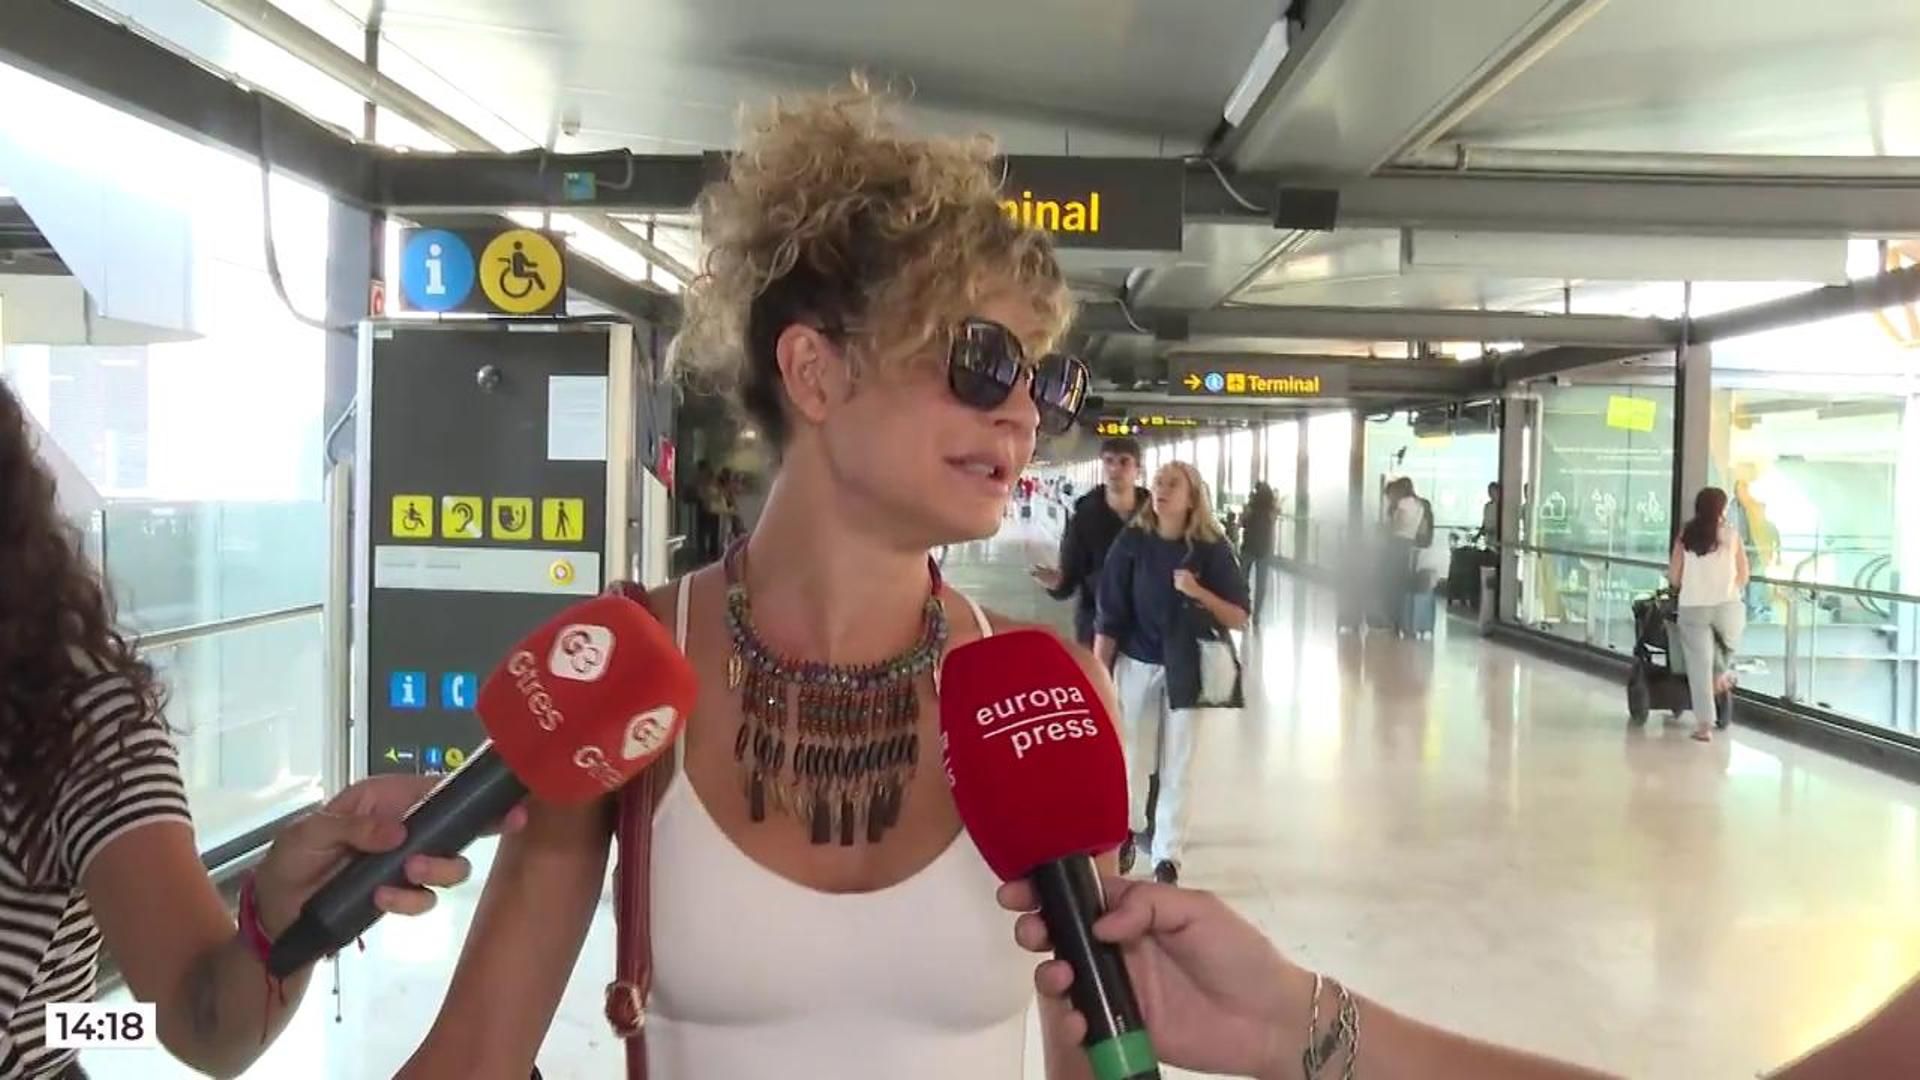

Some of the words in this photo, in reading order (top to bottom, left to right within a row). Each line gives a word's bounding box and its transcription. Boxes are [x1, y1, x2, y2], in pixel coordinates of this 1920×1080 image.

[999, 190, 1099, 231] inal
[1248, 375, 1320, 393] Terminal
[976, 686, 1085, 726] europa
[1011, 718, 1099, 759] press
